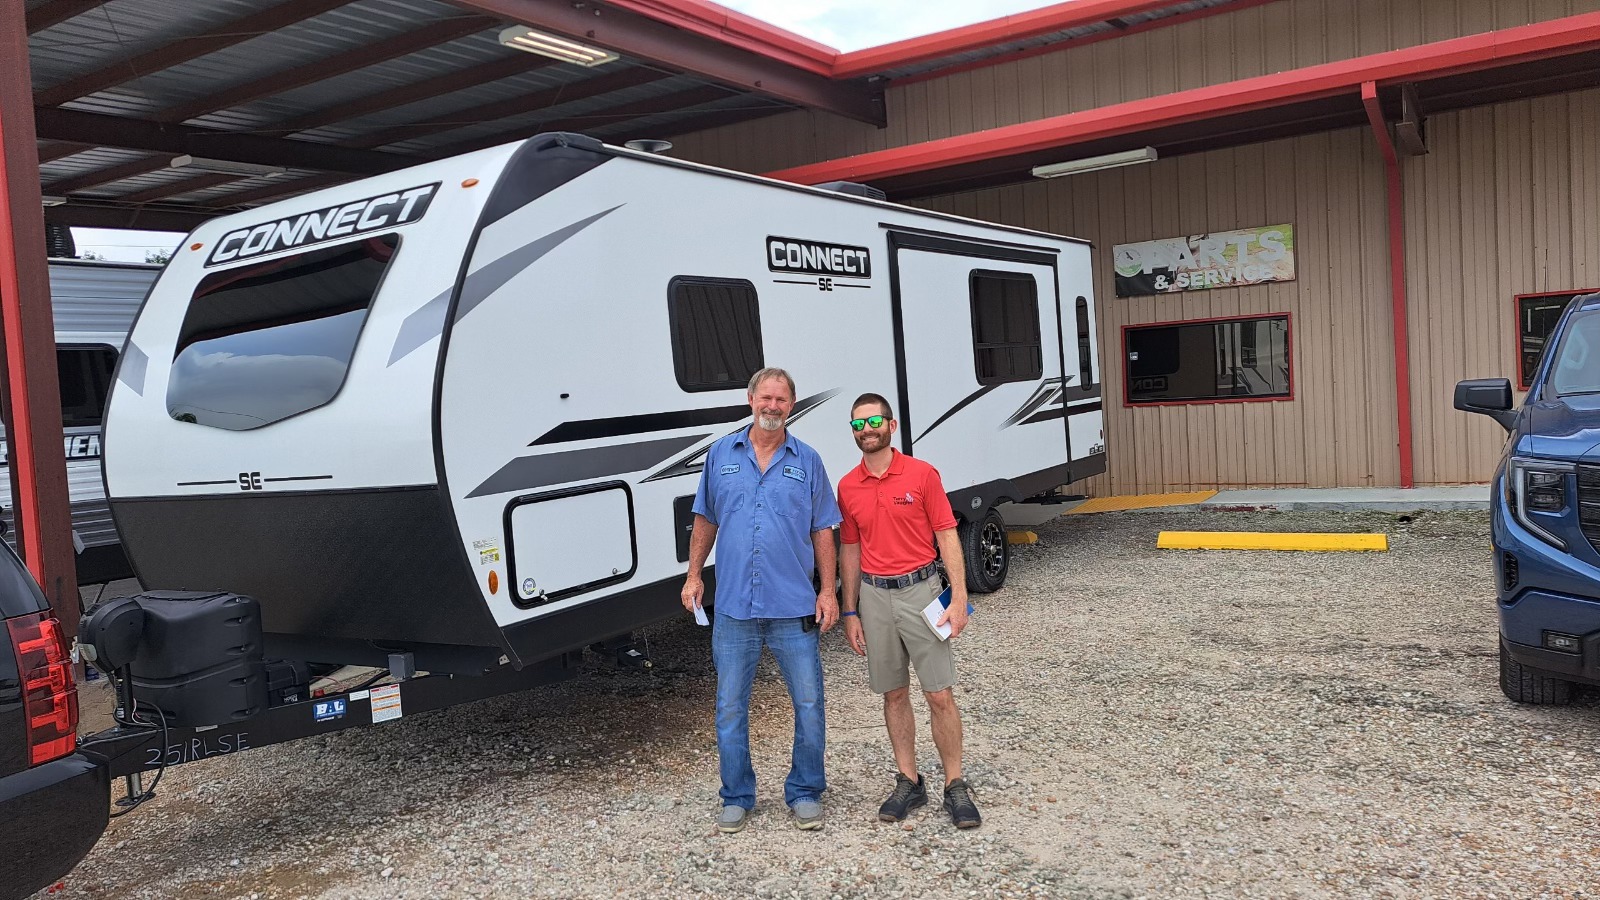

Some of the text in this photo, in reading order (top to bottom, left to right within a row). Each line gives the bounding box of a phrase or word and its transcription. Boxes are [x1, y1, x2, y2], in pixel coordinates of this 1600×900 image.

[211, 185, 434, 263] CONNECT
[770, 240, 868, 274] CONNECT
[1140, 230, 1286, 275] PARTS
[818, 277, 833, 291] SE
[1154, 264, 1273, 290] & SERVICE
[238, 472, 263, 490] SE
